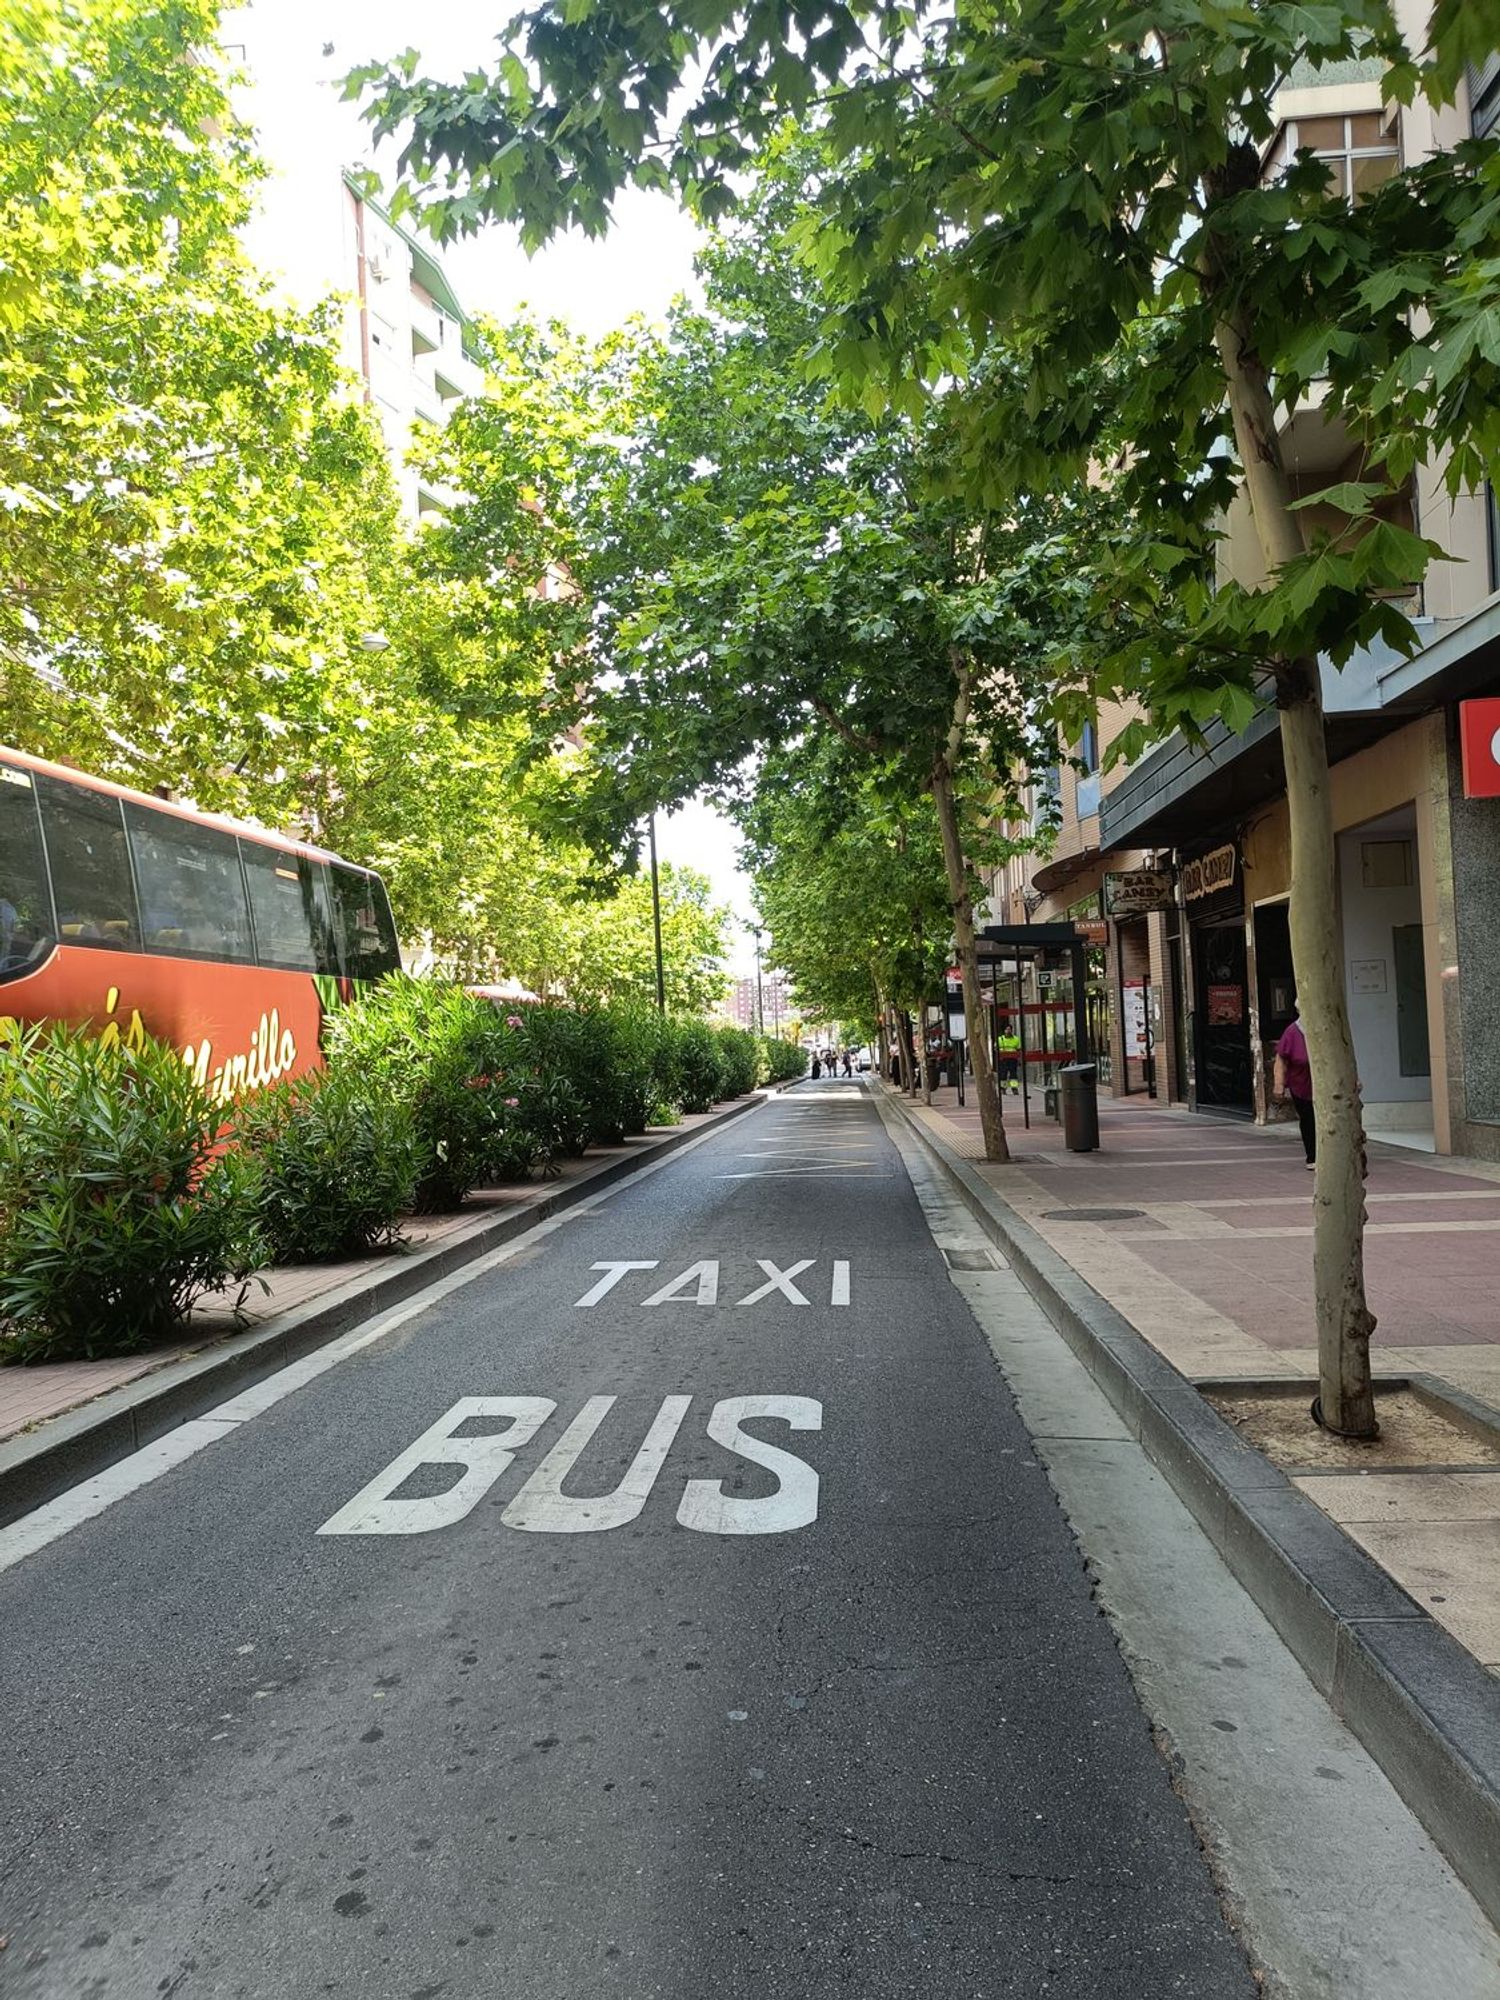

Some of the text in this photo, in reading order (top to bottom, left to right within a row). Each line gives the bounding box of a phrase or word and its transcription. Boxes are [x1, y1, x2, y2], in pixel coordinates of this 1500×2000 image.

[1123, 876, 1155, 888] BAR
[573, 1259, 851, 1307] TAXI
[315, 1395, 823, 1535] BUS
